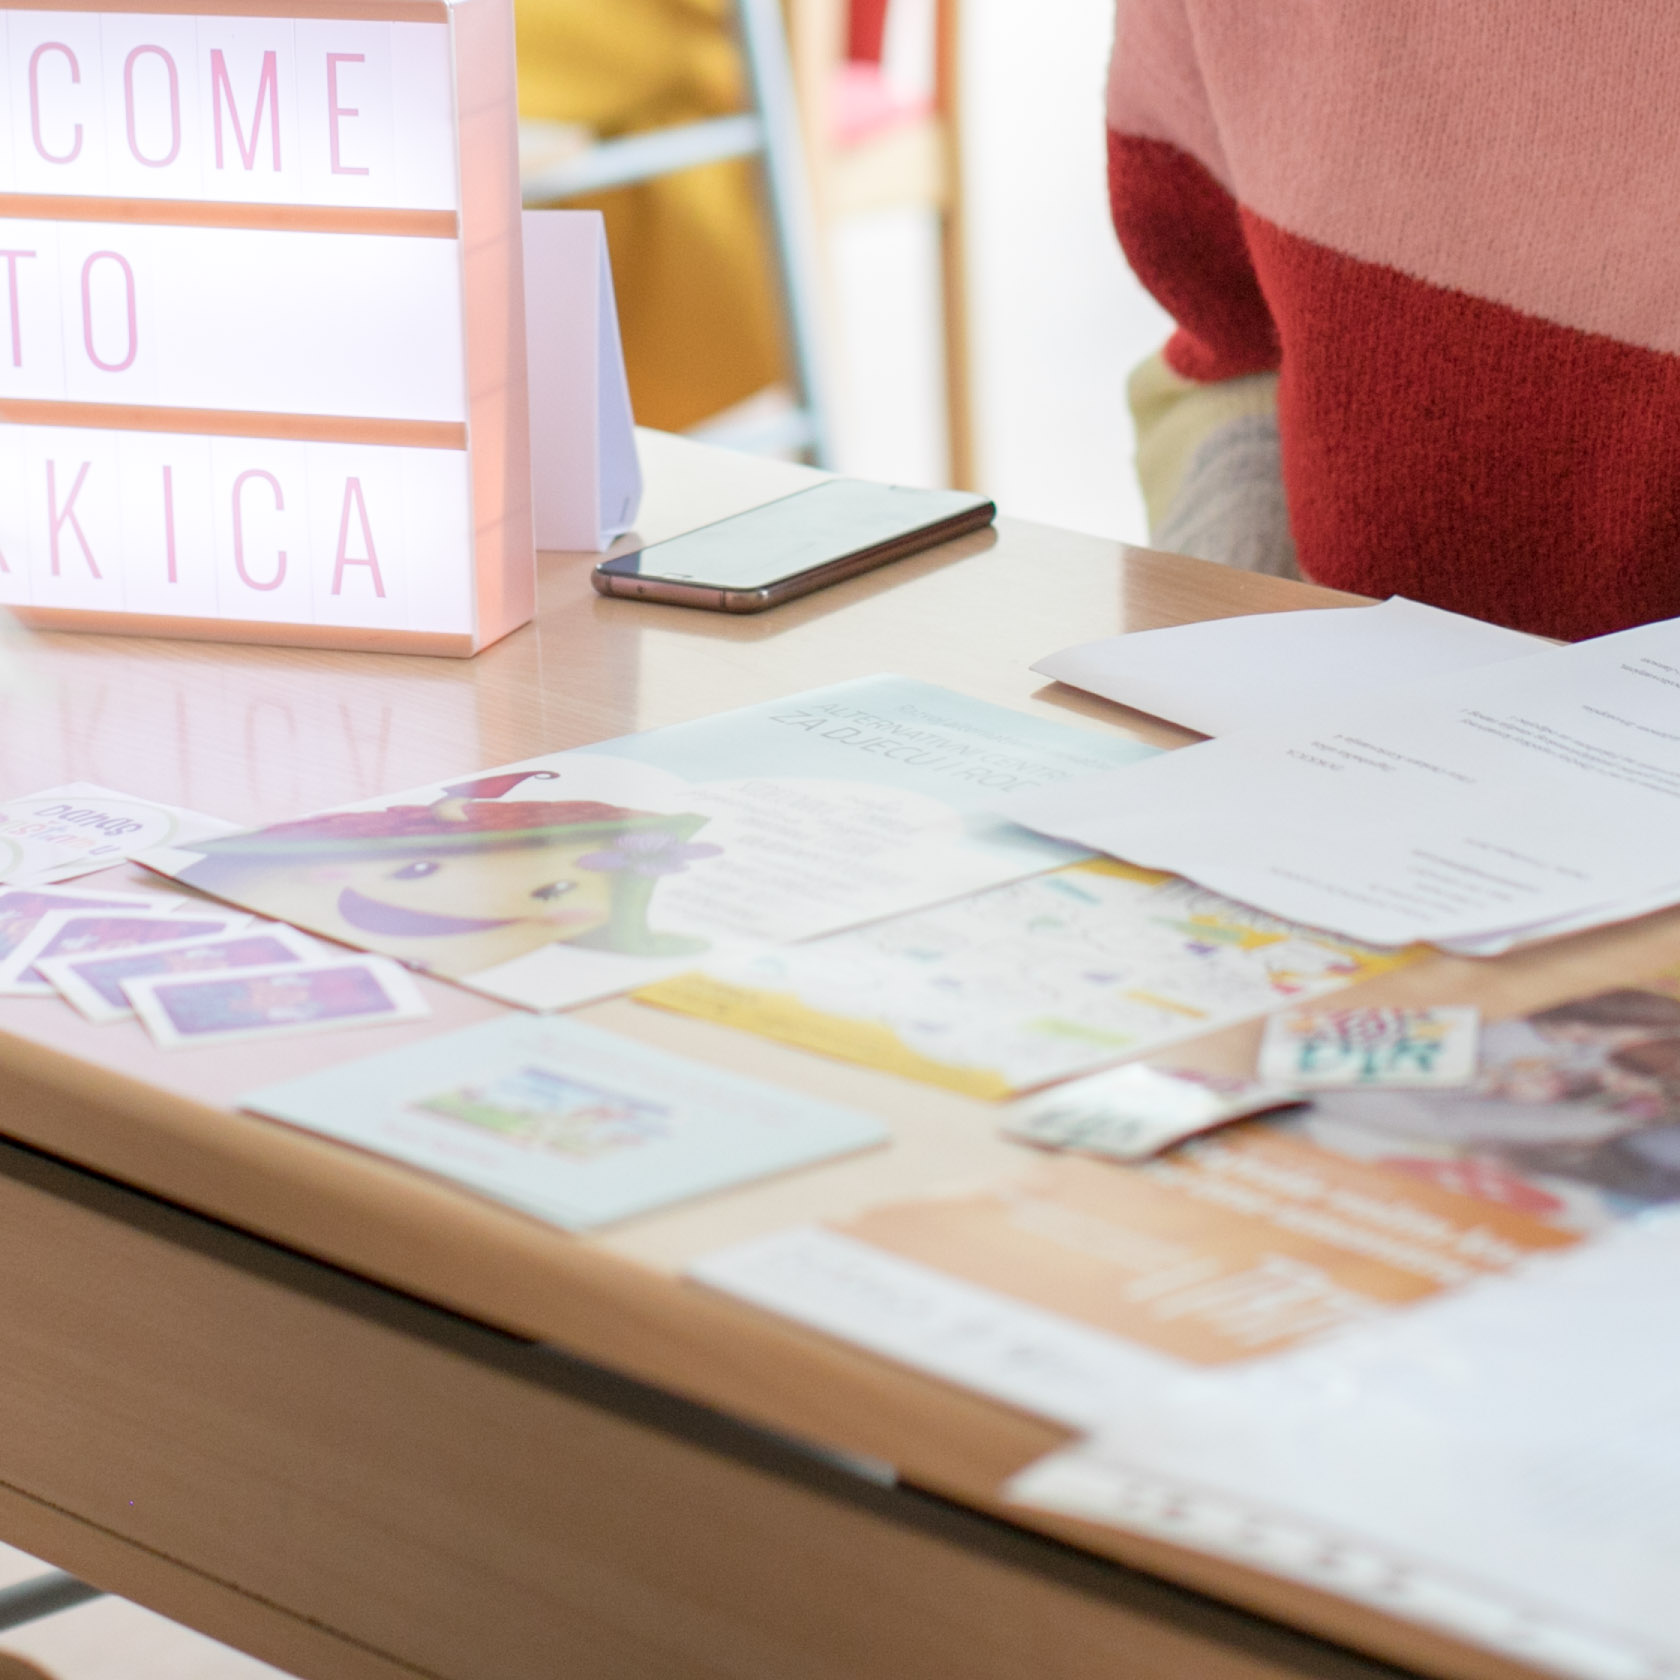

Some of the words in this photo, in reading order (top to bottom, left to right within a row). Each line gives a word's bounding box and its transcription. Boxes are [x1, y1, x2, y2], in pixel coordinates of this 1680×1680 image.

[769, 709, 827, 732] ZA
[820, 725, 932, 766] DJECU
[981, 752, 1069, 781] CENTR
